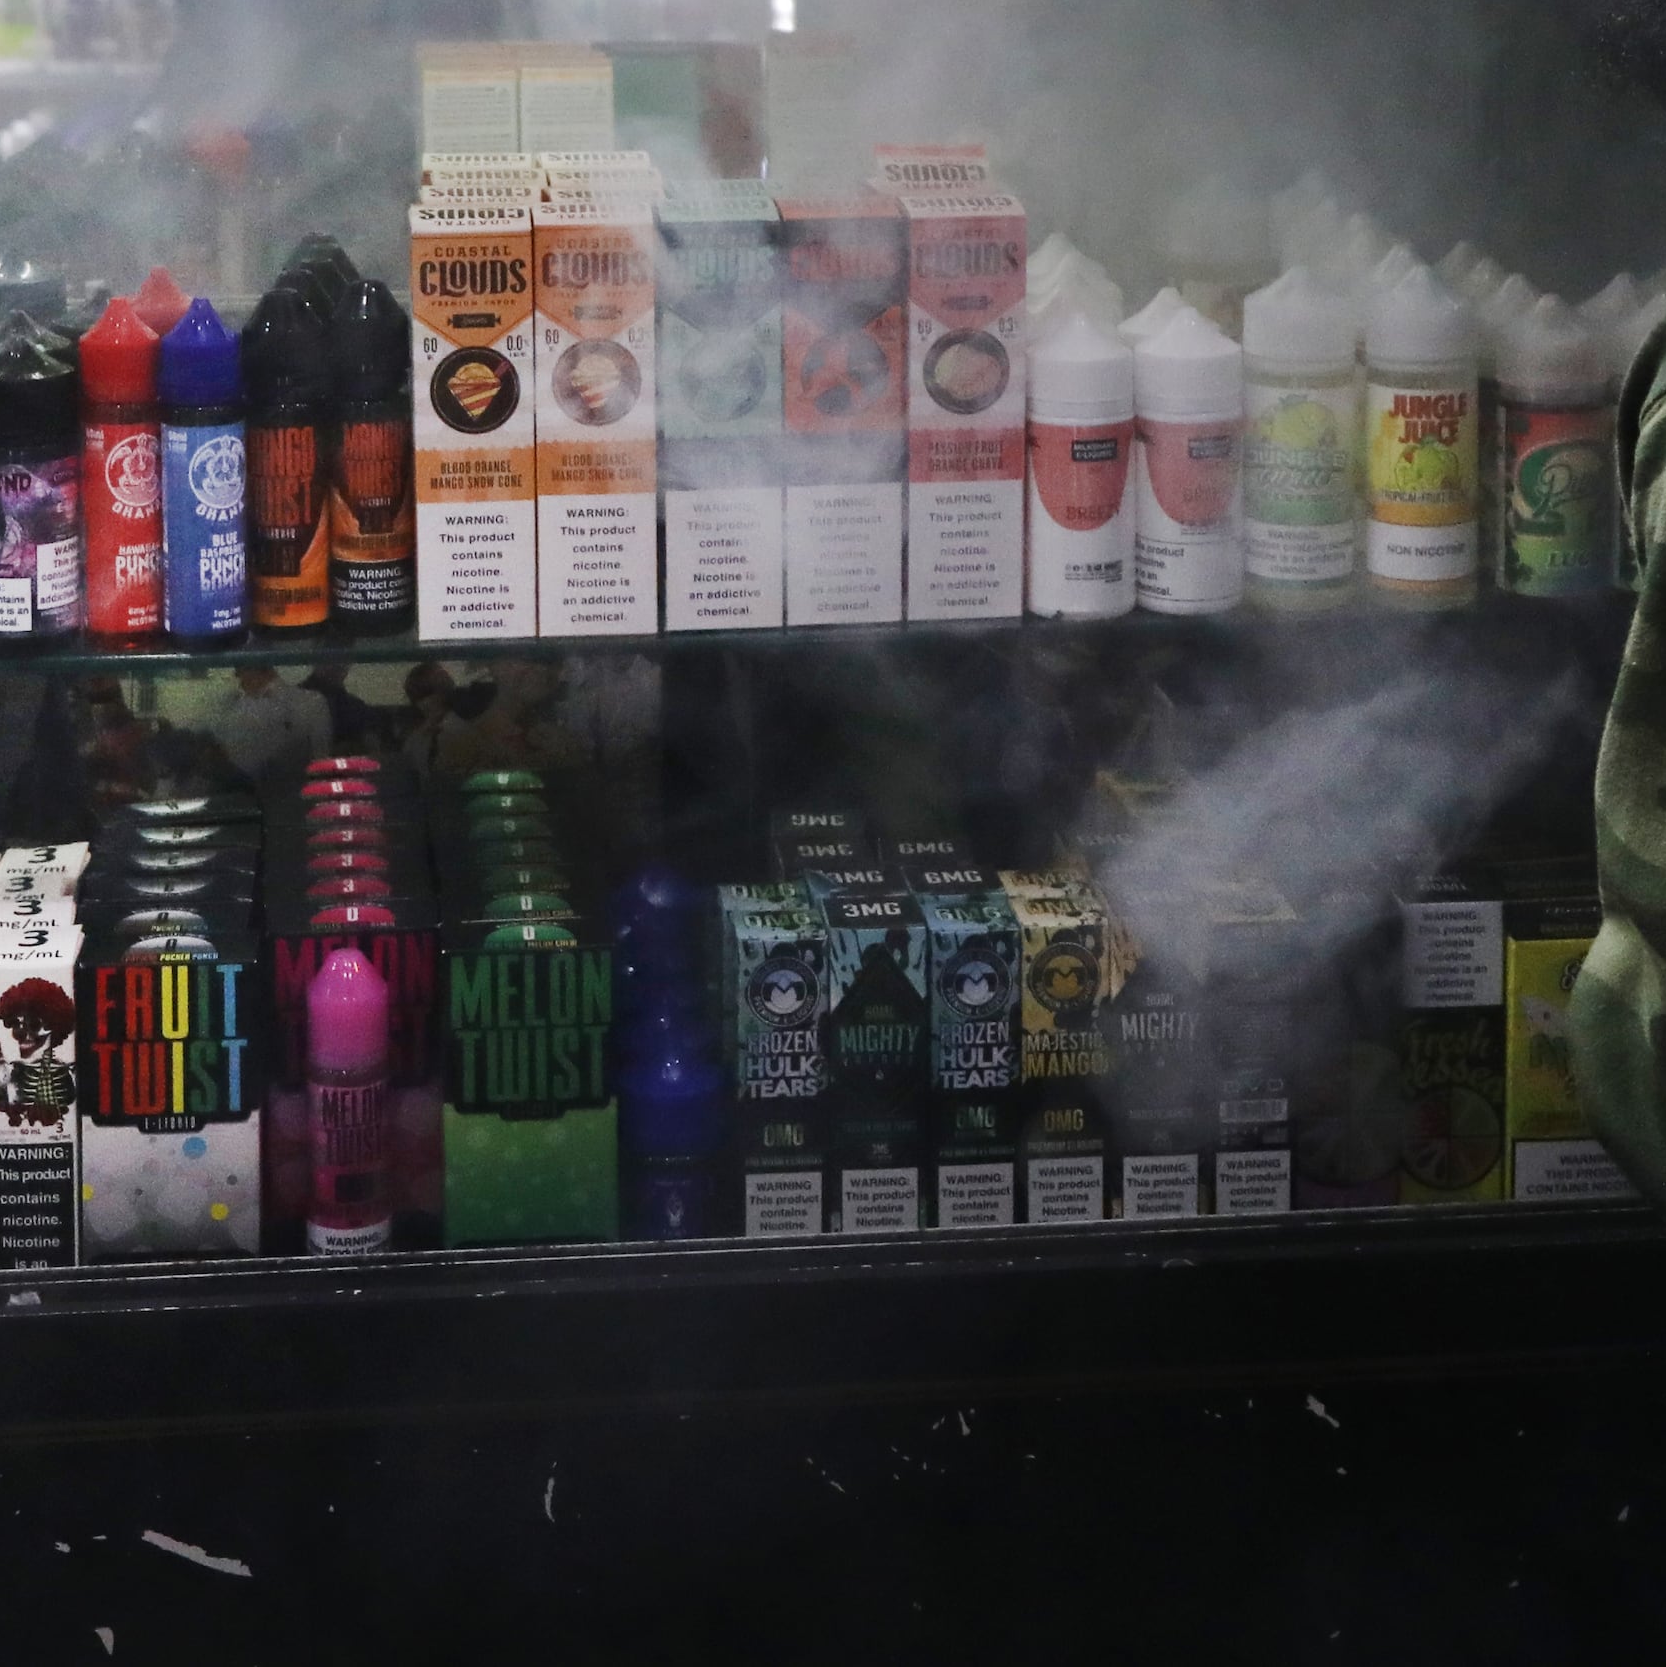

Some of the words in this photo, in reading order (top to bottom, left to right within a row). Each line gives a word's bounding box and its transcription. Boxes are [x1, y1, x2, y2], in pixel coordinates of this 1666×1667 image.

[435, 246, 512, 259] COASTAL
[419, 259, 527, 298] CLOUDS
[1389, 393, 1468, 419] JUNGLE
[212, 532, 237, 546] BLUE
[842, 901, 902, 918] 3MG
[96, 964, 243, 1039] FRUIT
[450, 951, 612, 1028] MELON
[940, 1021, 1009, 1045] FROZEN
[459, 1031, 607, 1103] TWIST
[939, 1046, 1009, 1069] HULK
[1026, 1053, 1105, 1078] MANGO
[91, 1039, 248, 1116] TWIST
[939, 1068, 1009, 1089] TEARS
